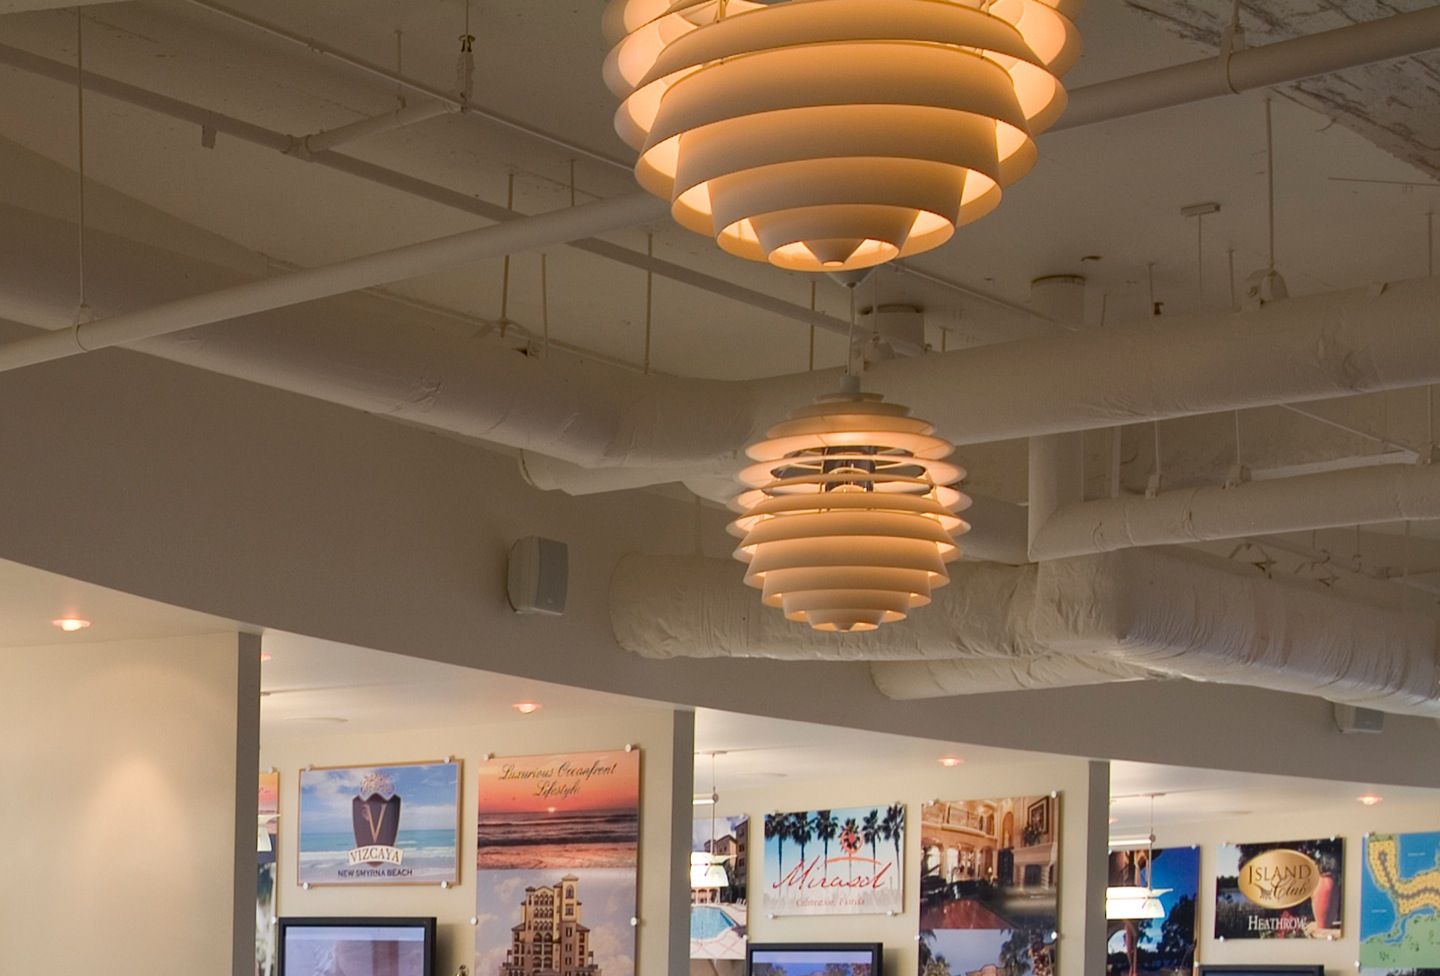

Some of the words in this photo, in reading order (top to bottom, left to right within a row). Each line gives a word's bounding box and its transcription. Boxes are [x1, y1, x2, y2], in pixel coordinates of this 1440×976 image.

[499, 763, 554, 780] Luxurious
[558, 760, 618, 780] Oceanfront
[533, 780, 581, 799] Lifestyle
[350, 847, 400, 862] VIZCAYA
[337, 870, 354, 878] NEW
[356, 869, 385, 877] SMYRNA
[387, 868, 413, 877] BEACH
[772, 855, 892, 890] Mirasol
[1272, 876, 1309, 900] Club
